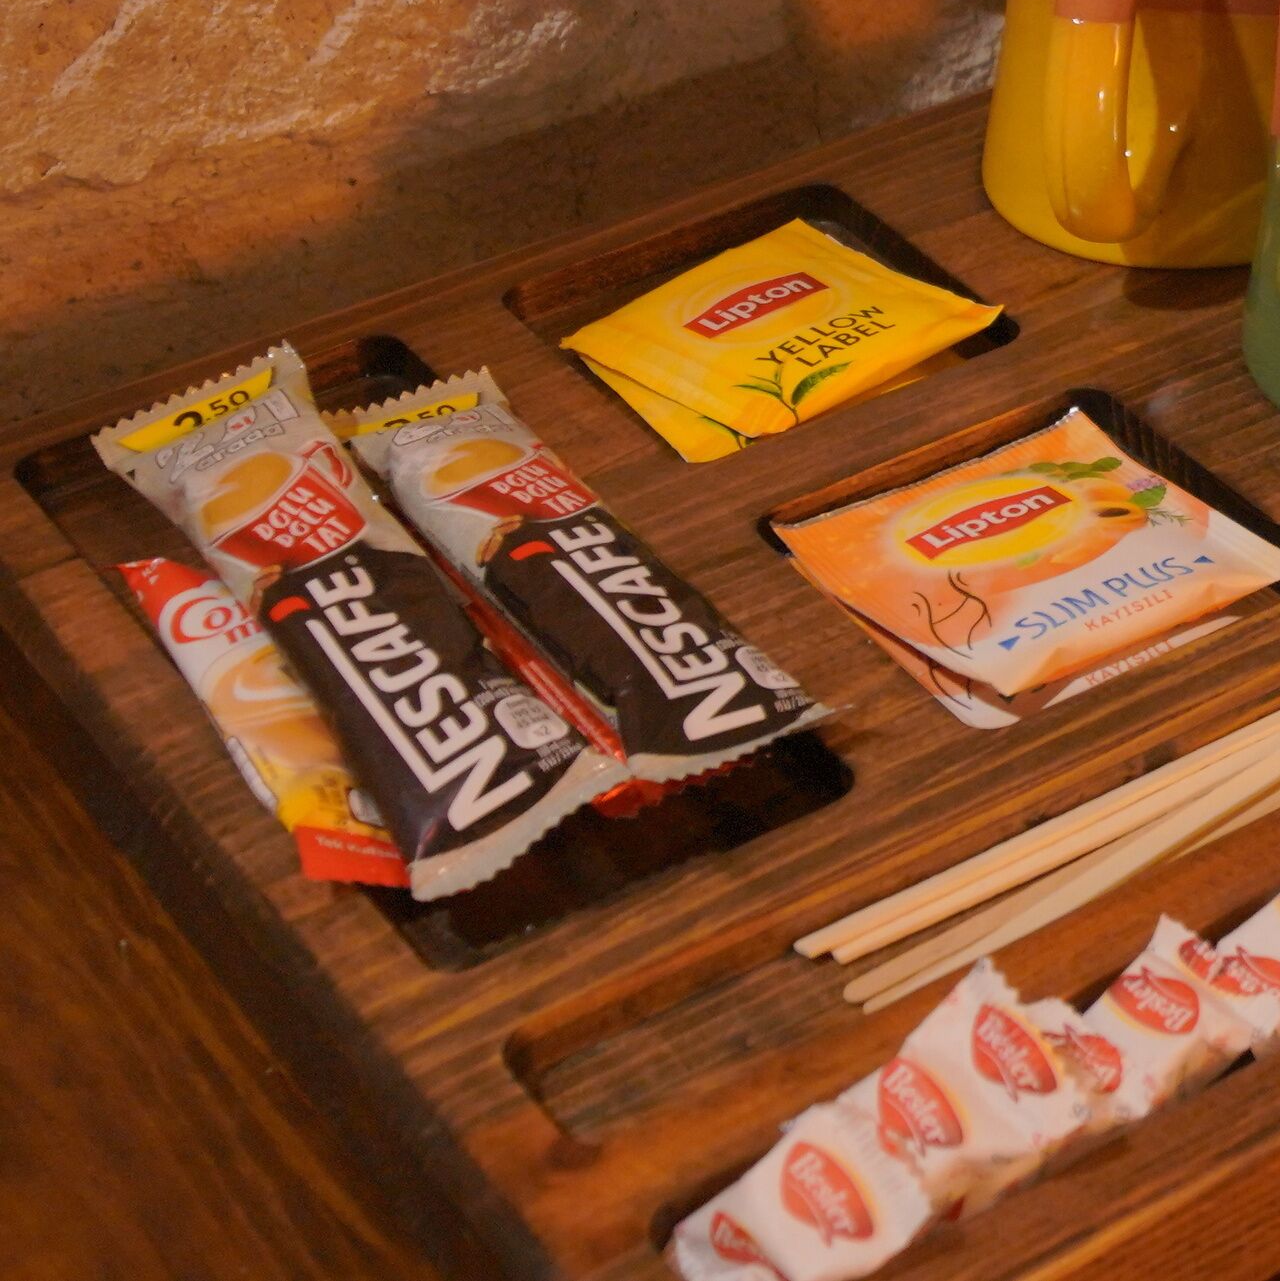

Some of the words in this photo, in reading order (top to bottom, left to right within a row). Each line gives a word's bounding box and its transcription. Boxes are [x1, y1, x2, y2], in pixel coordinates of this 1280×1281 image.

[697, 277, 815, 332] Lipton
[755, 305, 885, 365] YELLOW
[795, 321, 896, 368] LABEL
[301, 517, 353, 554] TAT
[920, 492, 1056, 549] Lipton
[1013, 588, 1106, 640] SLIM
[1102, 556, 1196, 598] PLUS
[1083, 588, 1175, 632] KAYISILI
